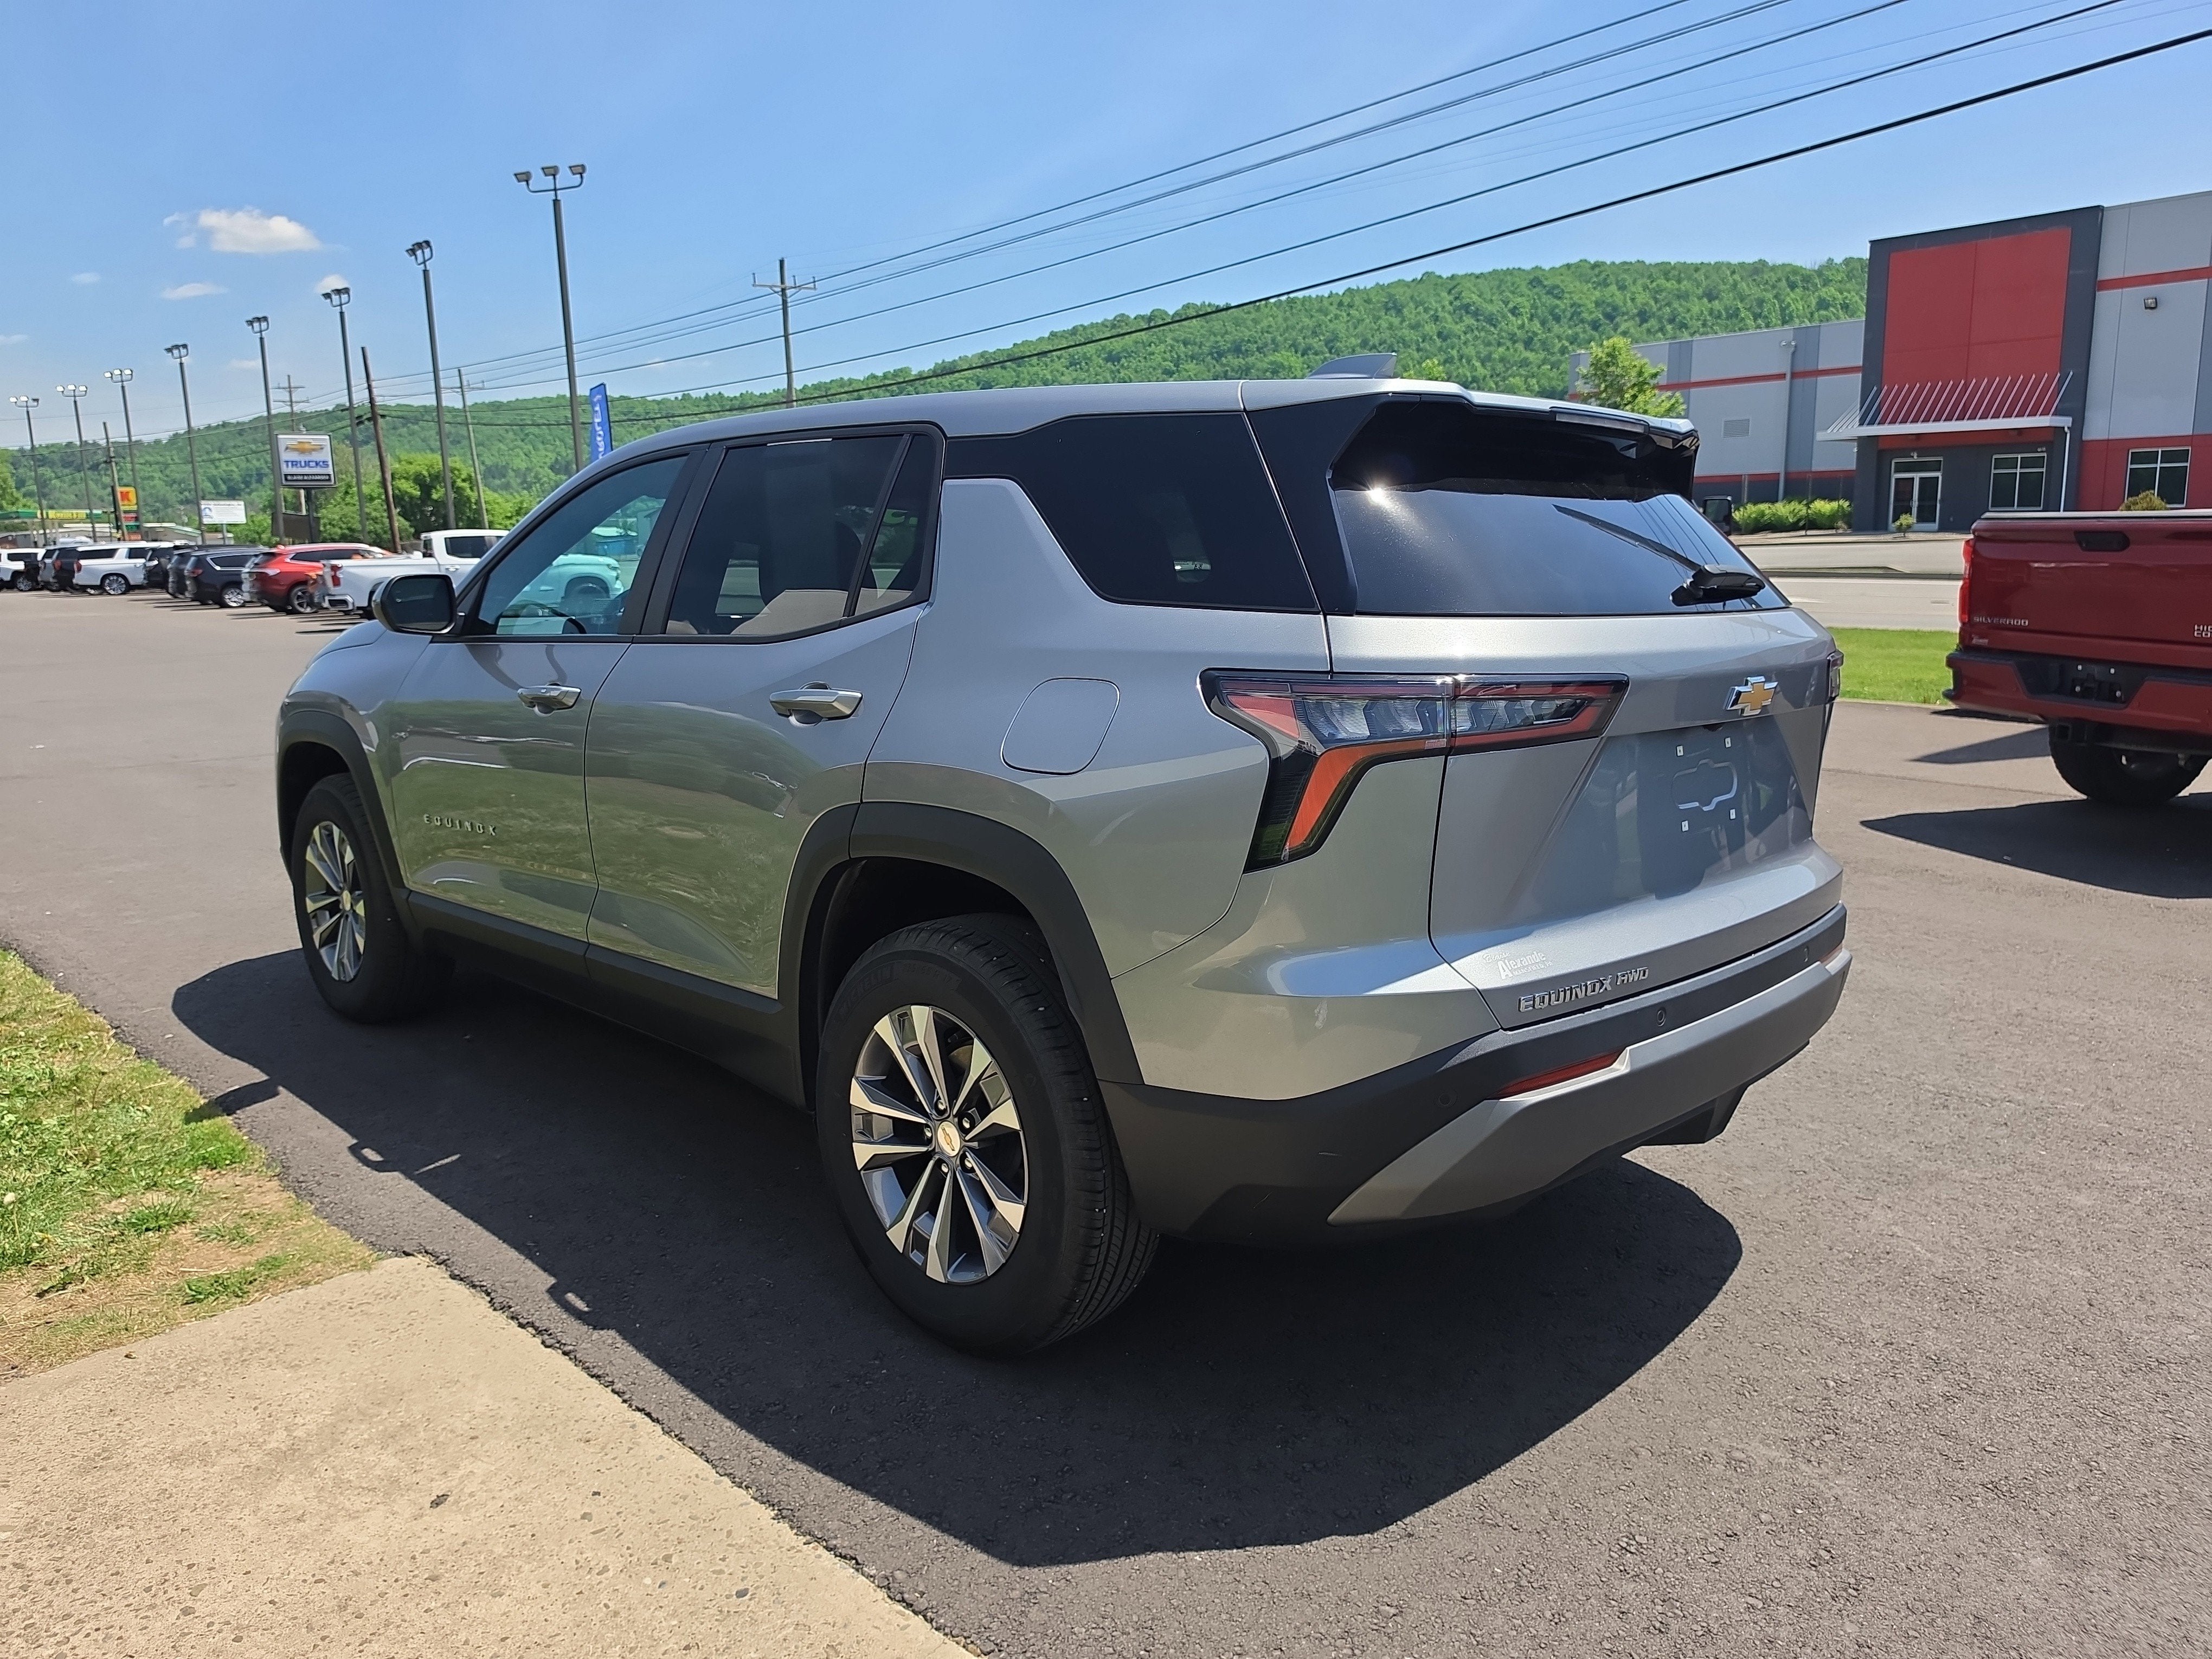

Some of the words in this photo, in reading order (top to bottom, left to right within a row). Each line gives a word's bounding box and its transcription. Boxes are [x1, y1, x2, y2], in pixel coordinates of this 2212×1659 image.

[284, 460, 330, 468] TRUCKS
[1973, 616, 2029, 626] SILVERADO
[423, 813, 496, 836] EQUINOX
[1519, 975, 1612, 1012] EQUINOX
[1616, 967, 1649, 986] AWD
